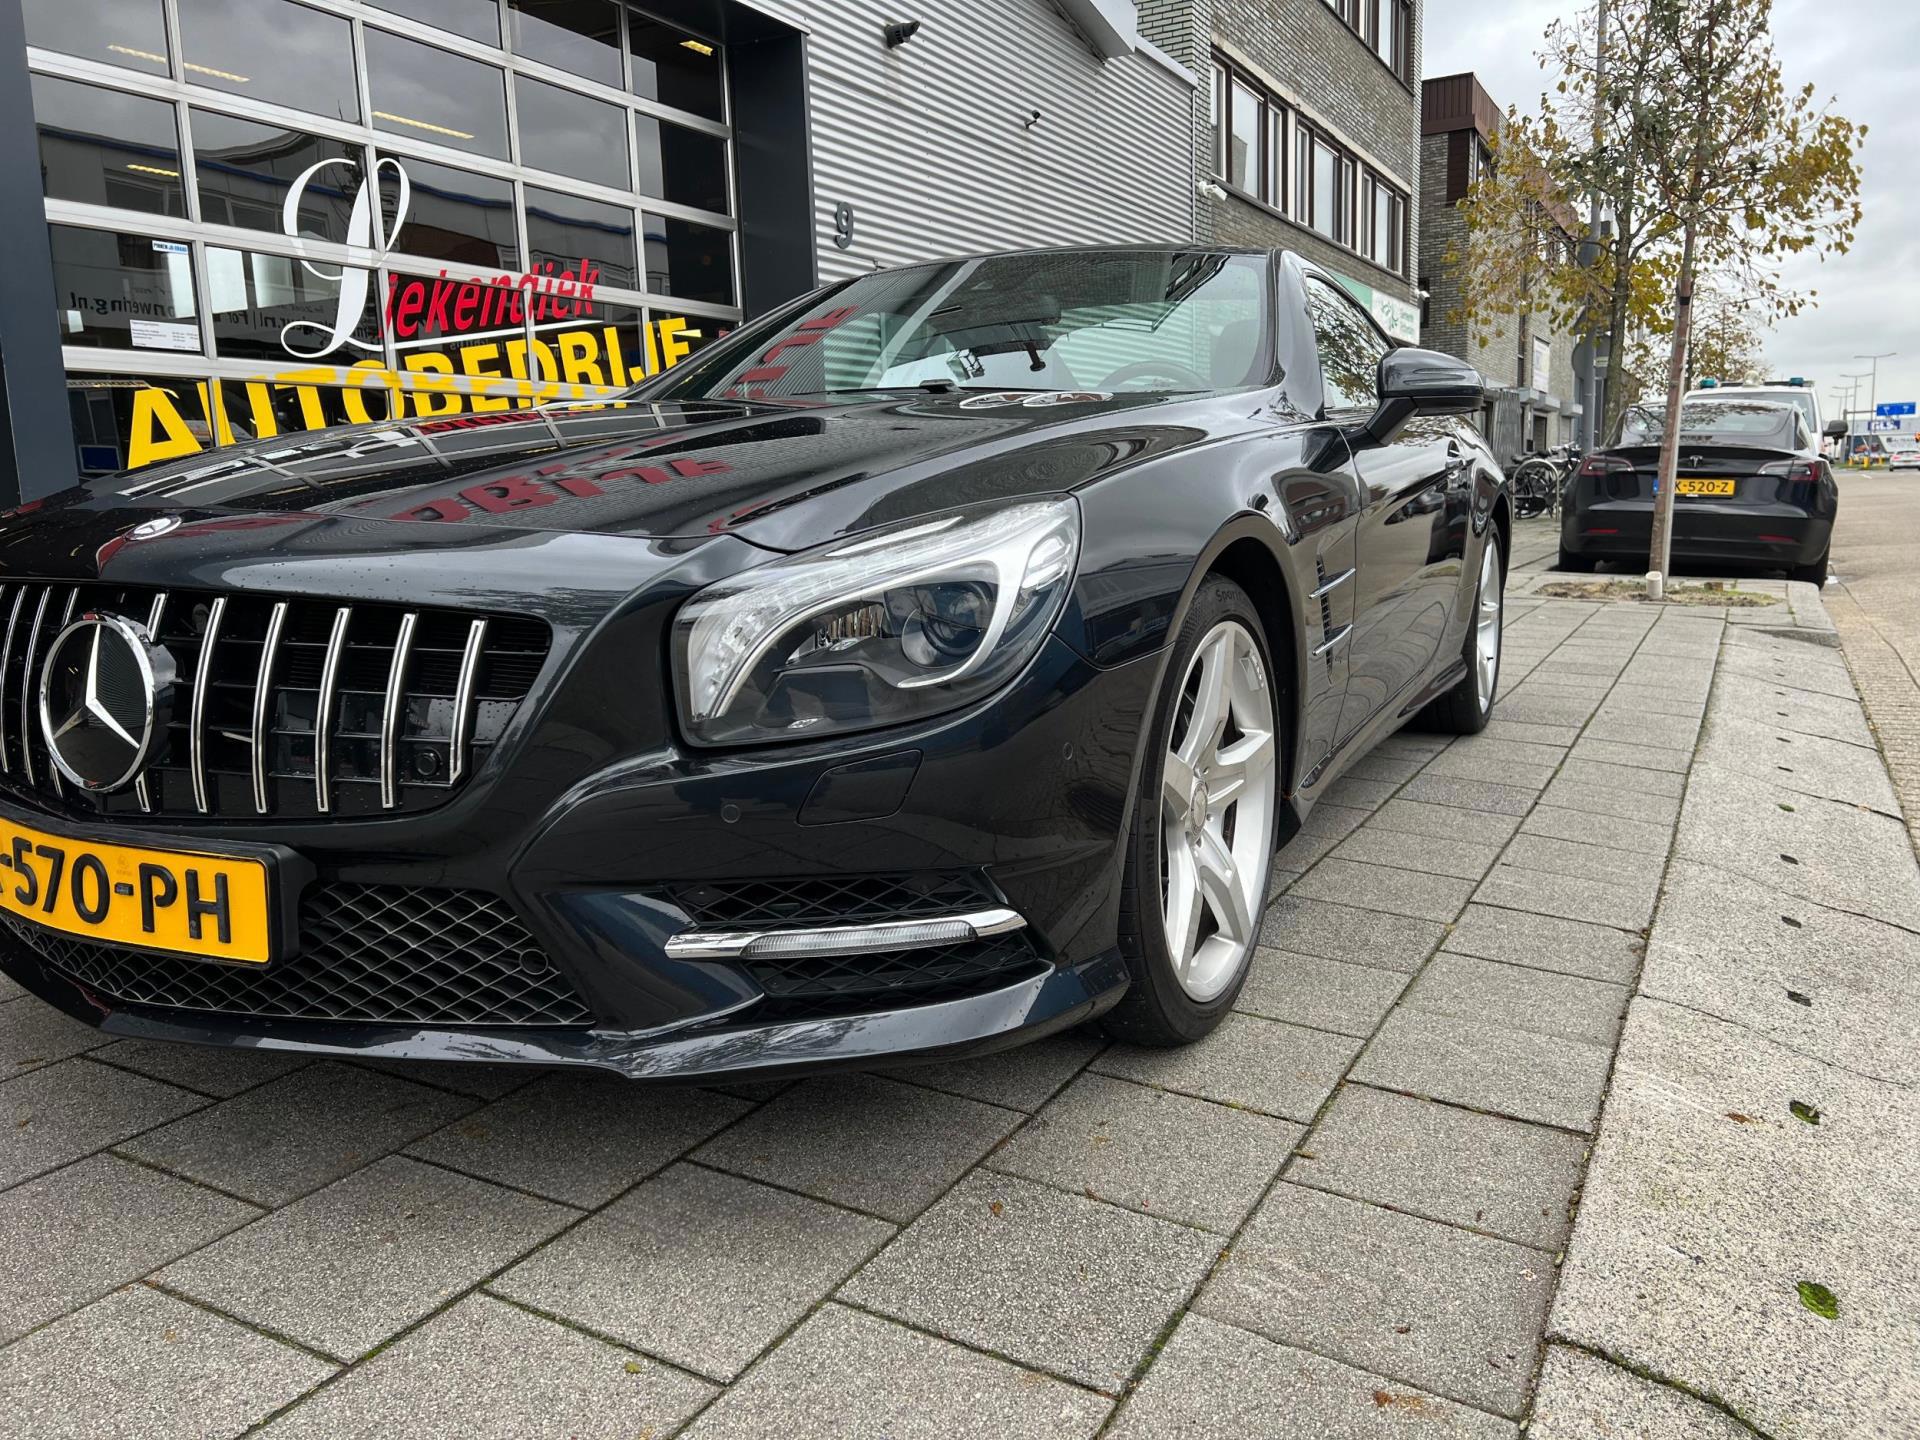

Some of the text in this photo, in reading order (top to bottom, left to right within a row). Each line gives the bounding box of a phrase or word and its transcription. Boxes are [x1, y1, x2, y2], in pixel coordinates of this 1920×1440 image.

[836, 201, 853, 250] 9
[127, 317, 690, 470] AUTOBEDRIJF
[0, 836, 231, 944] -570-PH
